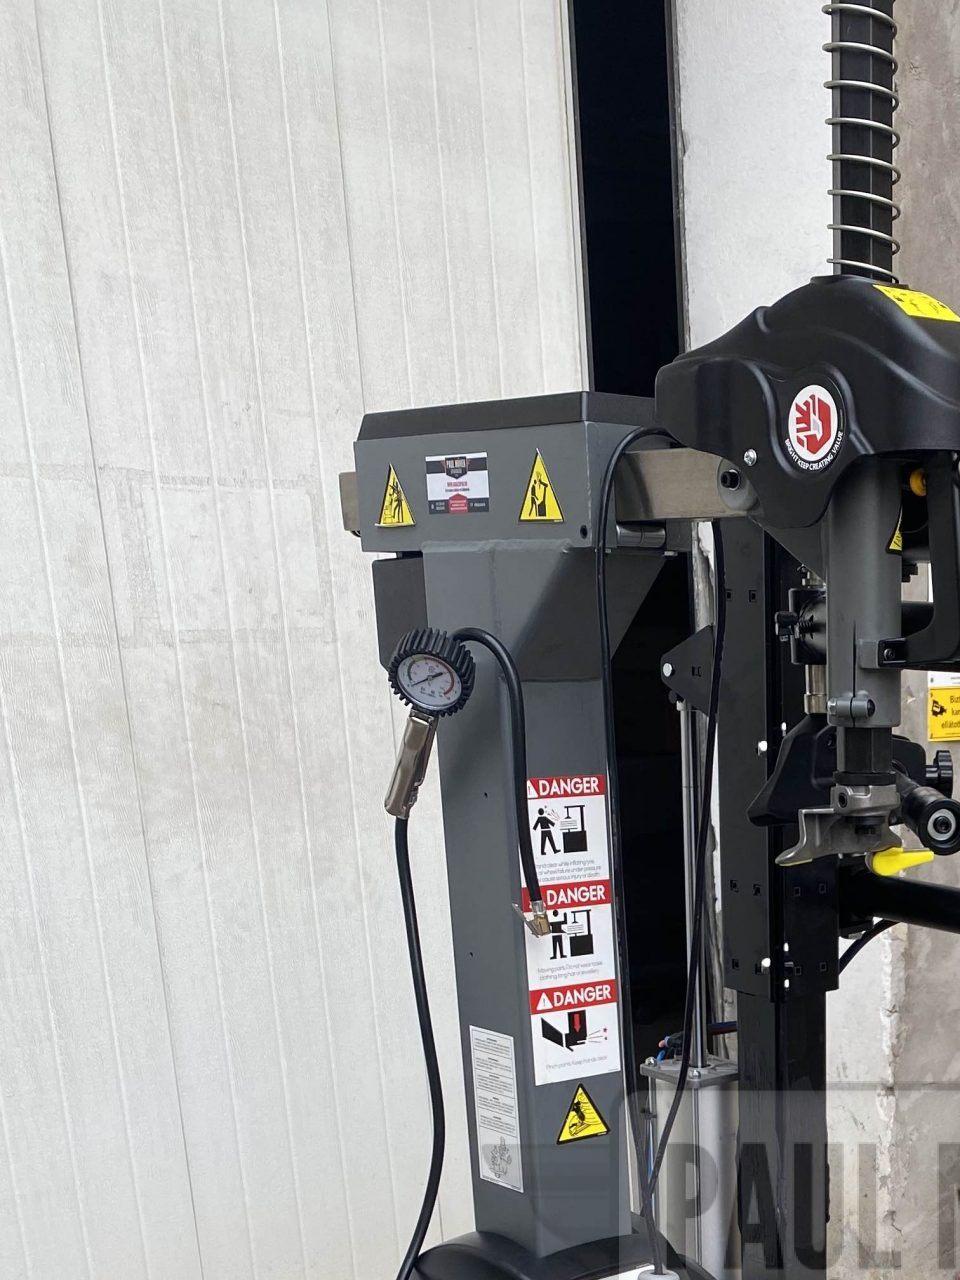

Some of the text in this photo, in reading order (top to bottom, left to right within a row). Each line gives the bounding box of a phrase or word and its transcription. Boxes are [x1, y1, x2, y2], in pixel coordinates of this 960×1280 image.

[809, 453, 834, 471] CREATING
[831, 430, 844, 455] VALUE
[538, 777, 600, 796] DANGER
[546, 885, 606, 906] DANGER
[552, 985, 612, 1007] DANGER
